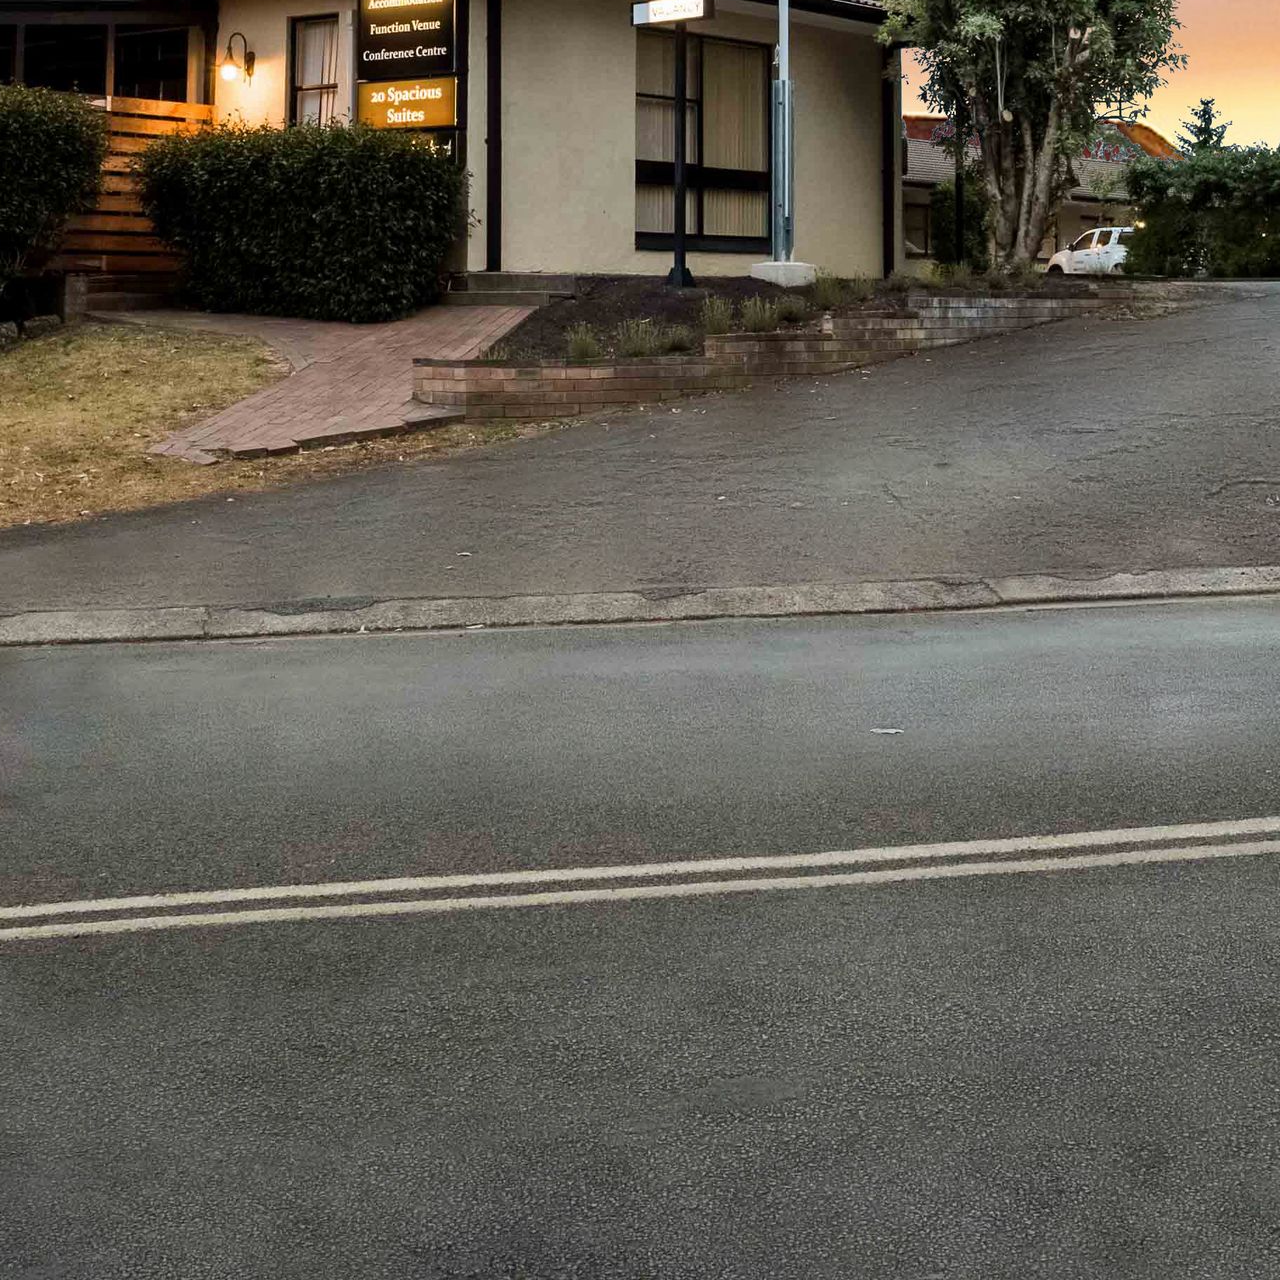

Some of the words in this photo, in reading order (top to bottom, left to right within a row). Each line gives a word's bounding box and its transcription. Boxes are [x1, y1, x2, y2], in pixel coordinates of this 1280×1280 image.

[370, 21, 410, 35] Function
[412, 20, 440, 32] Venue
[363, 47, 414, 61] Conference
[416, 45, 447, 58] Centre
[371, 92, 385, 103] 20
[387, 85, 442, 105] Spacious
[387, 108, 425, 123] Suites
